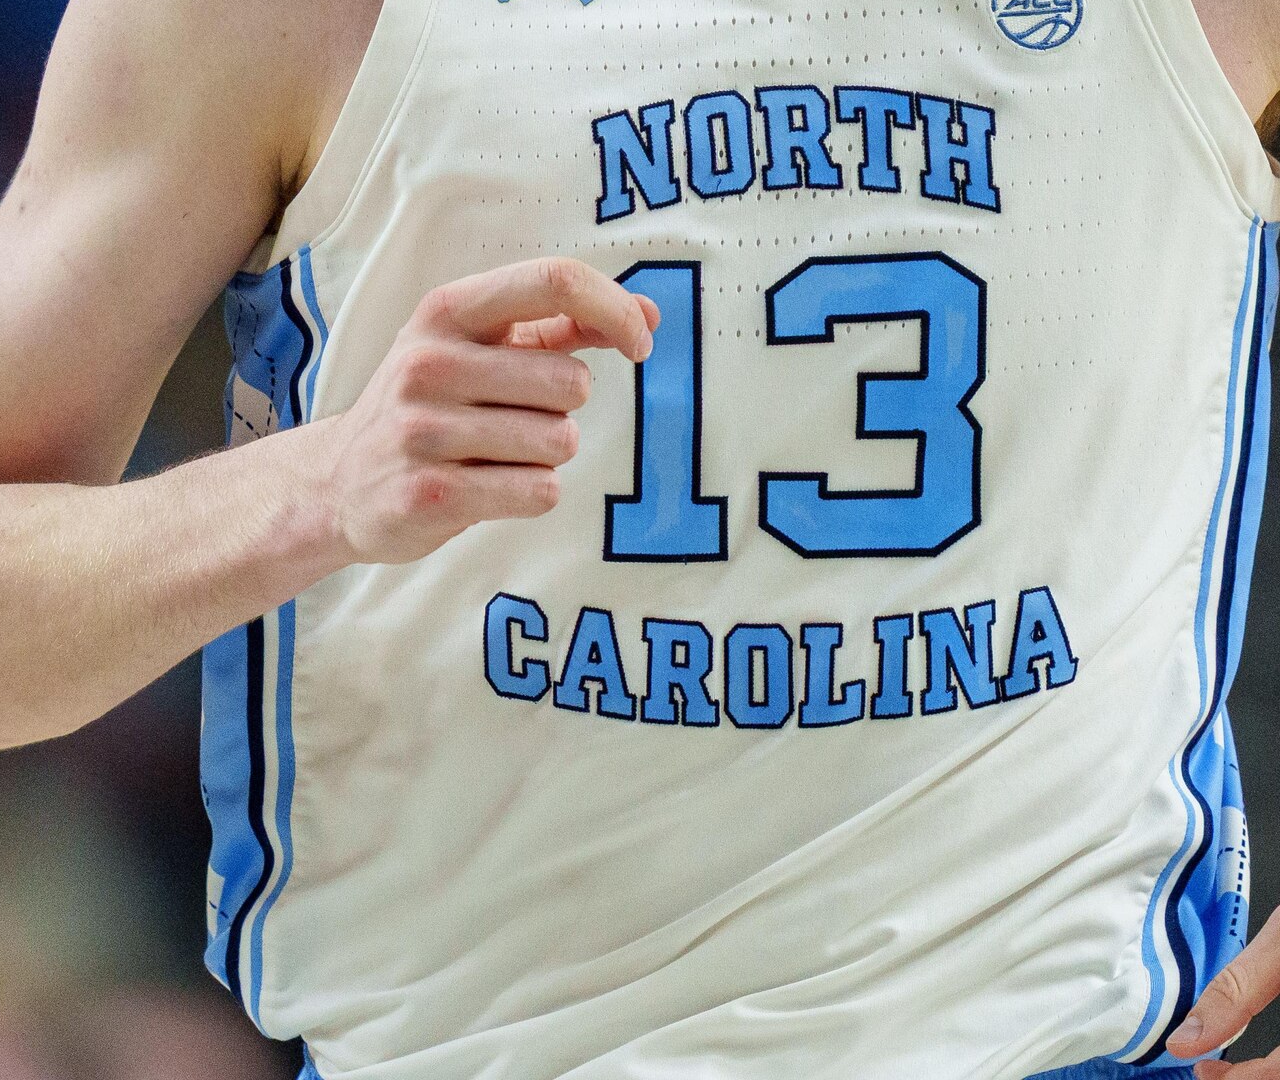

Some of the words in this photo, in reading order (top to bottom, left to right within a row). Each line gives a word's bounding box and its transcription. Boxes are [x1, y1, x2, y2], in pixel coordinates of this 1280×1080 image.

[592, 84, 1001, 224] NORTH
[603, 251, 987, 563] 13
[483, 586, 1079, 729] CAROLINA
